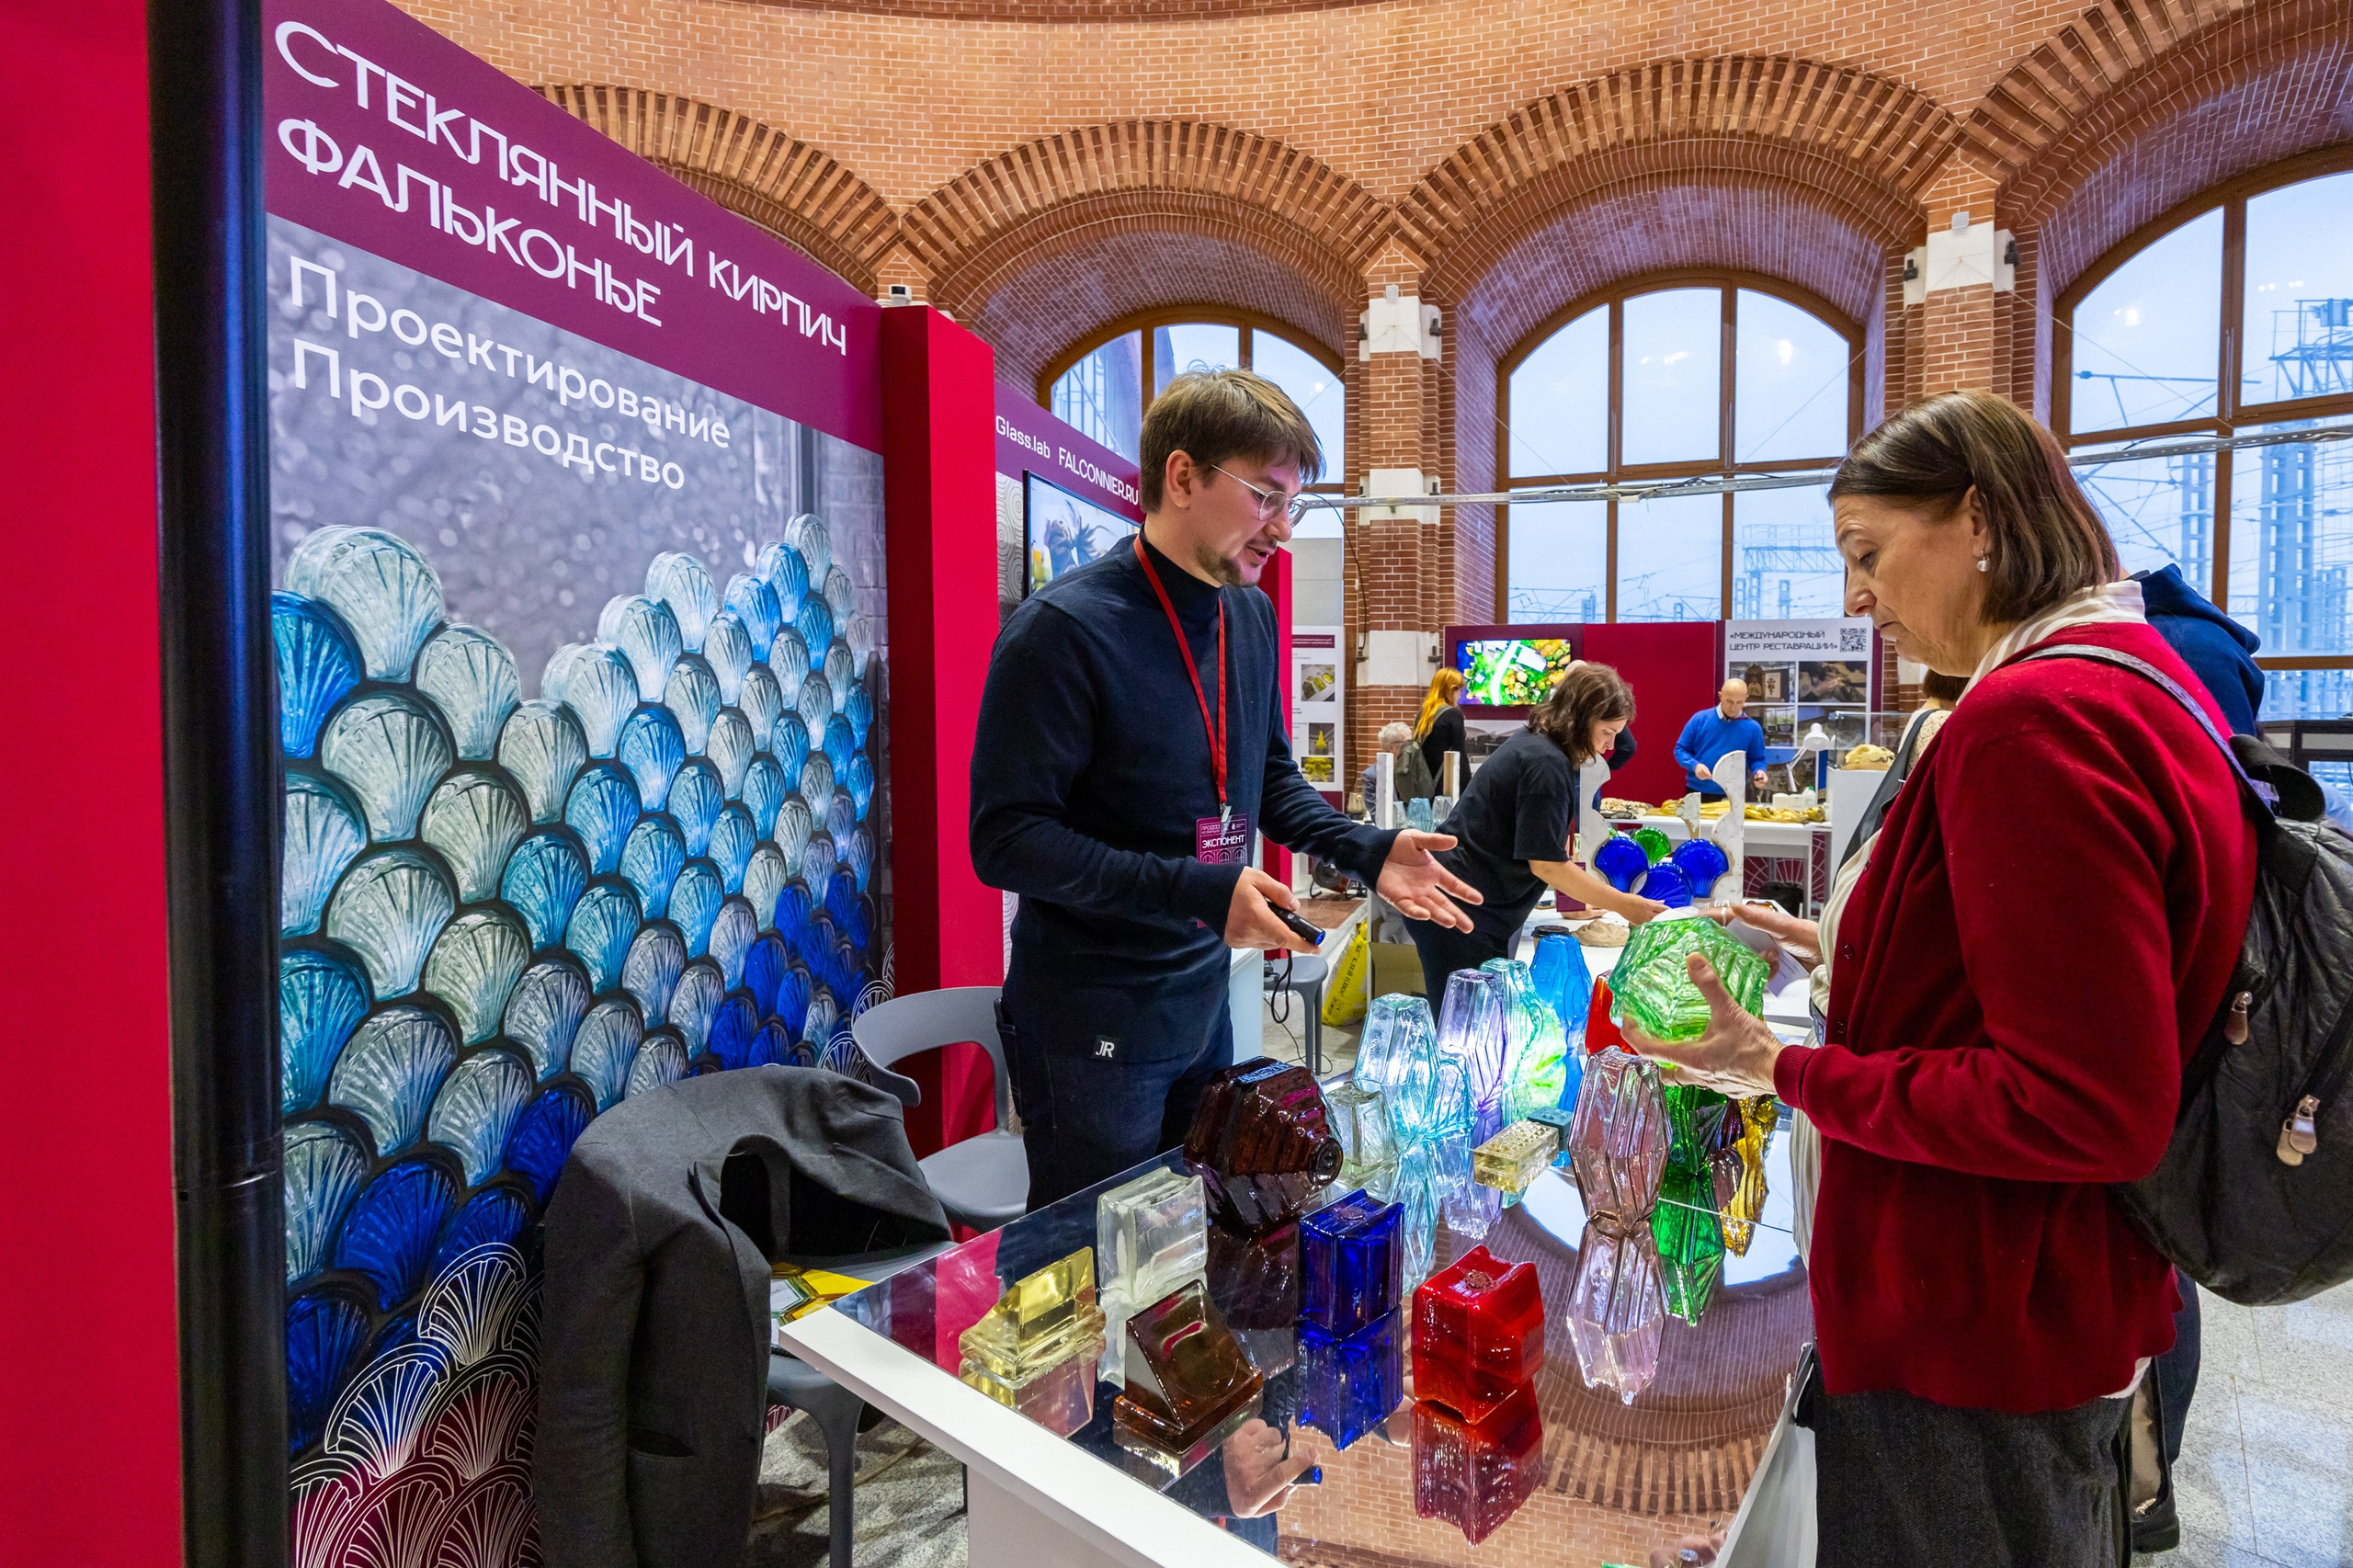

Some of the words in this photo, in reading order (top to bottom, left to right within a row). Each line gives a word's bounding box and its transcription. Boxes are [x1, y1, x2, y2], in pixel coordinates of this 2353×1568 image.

[275, 20, 694, 278] СТЕКЛЯННЫЙ
[709, 251, 847, 357] КИРПИЧ
[278, 118, 663, 327] ФАЛЬКОНЬЕ
[290, 255, 731, 449] Проектирование
[293, 337, 685, 491] Производство
[995, 415, 1051, 459] Glass.lab
[1059, 446, 1139, 506] FALCONNIER.RU
[1730, 630, 1825, 640] «МЕЖДУНАРОДНЫЙ
[1763, 642, 1838, 651] РЕСТАВРАЦИИ»
[1201, 835, 1245, 848] ЭКСПОНЕНТ
[1095, 1040, 1115, 1058] JR
